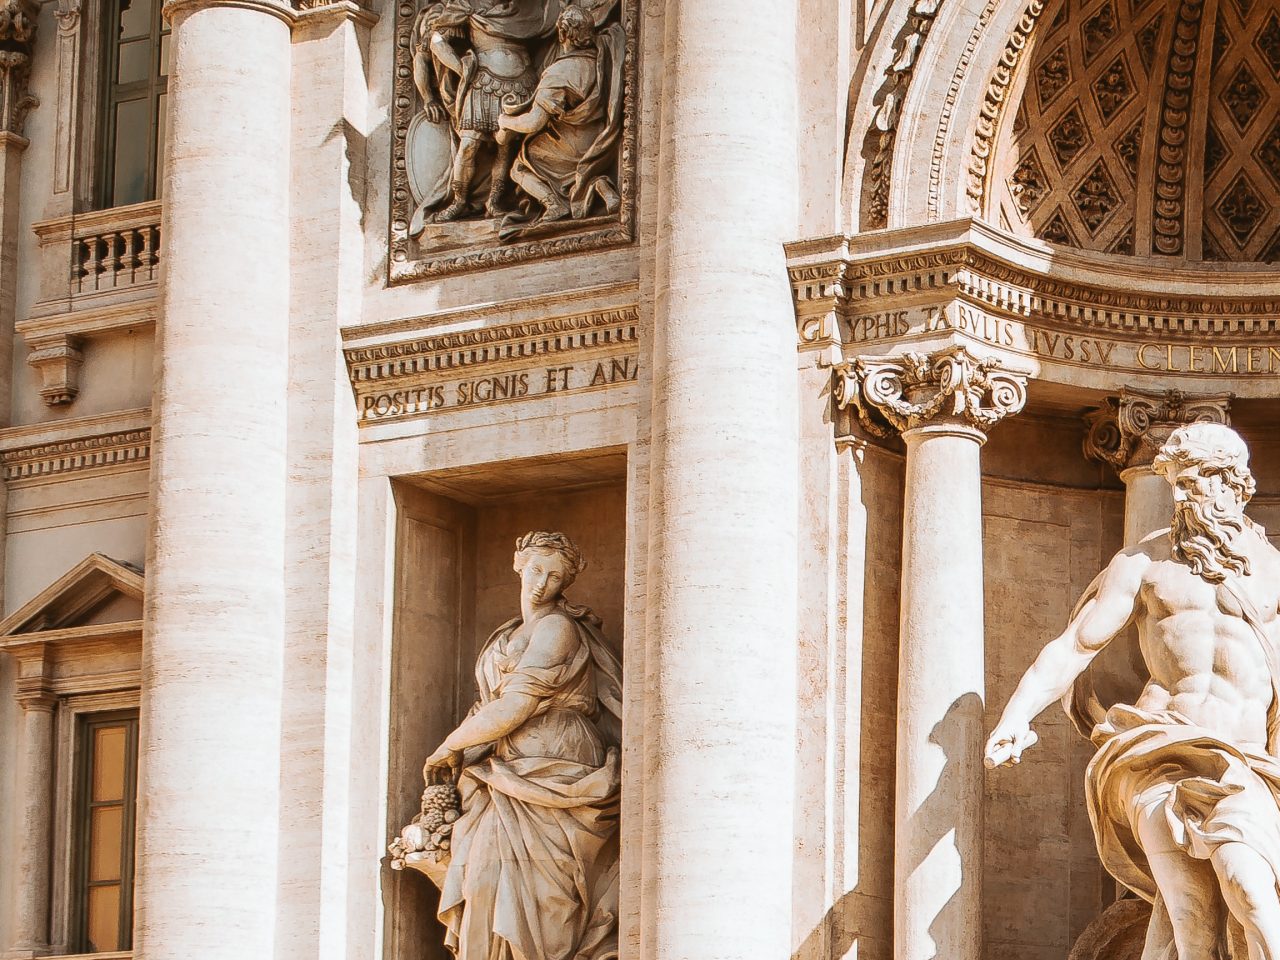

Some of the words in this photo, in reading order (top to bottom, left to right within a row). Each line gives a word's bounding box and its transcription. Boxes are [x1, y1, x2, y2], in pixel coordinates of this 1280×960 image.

[921, 304, 1014, 346] TABVLIS
[1032, 328, 1117, 364] IVSSV
[363, 385, 445, 420] POSITIS
[456, 373, 529, 405] SIGNIS
[545, 366, 574, 393] ET
[589, 356, 639, 386] AN
